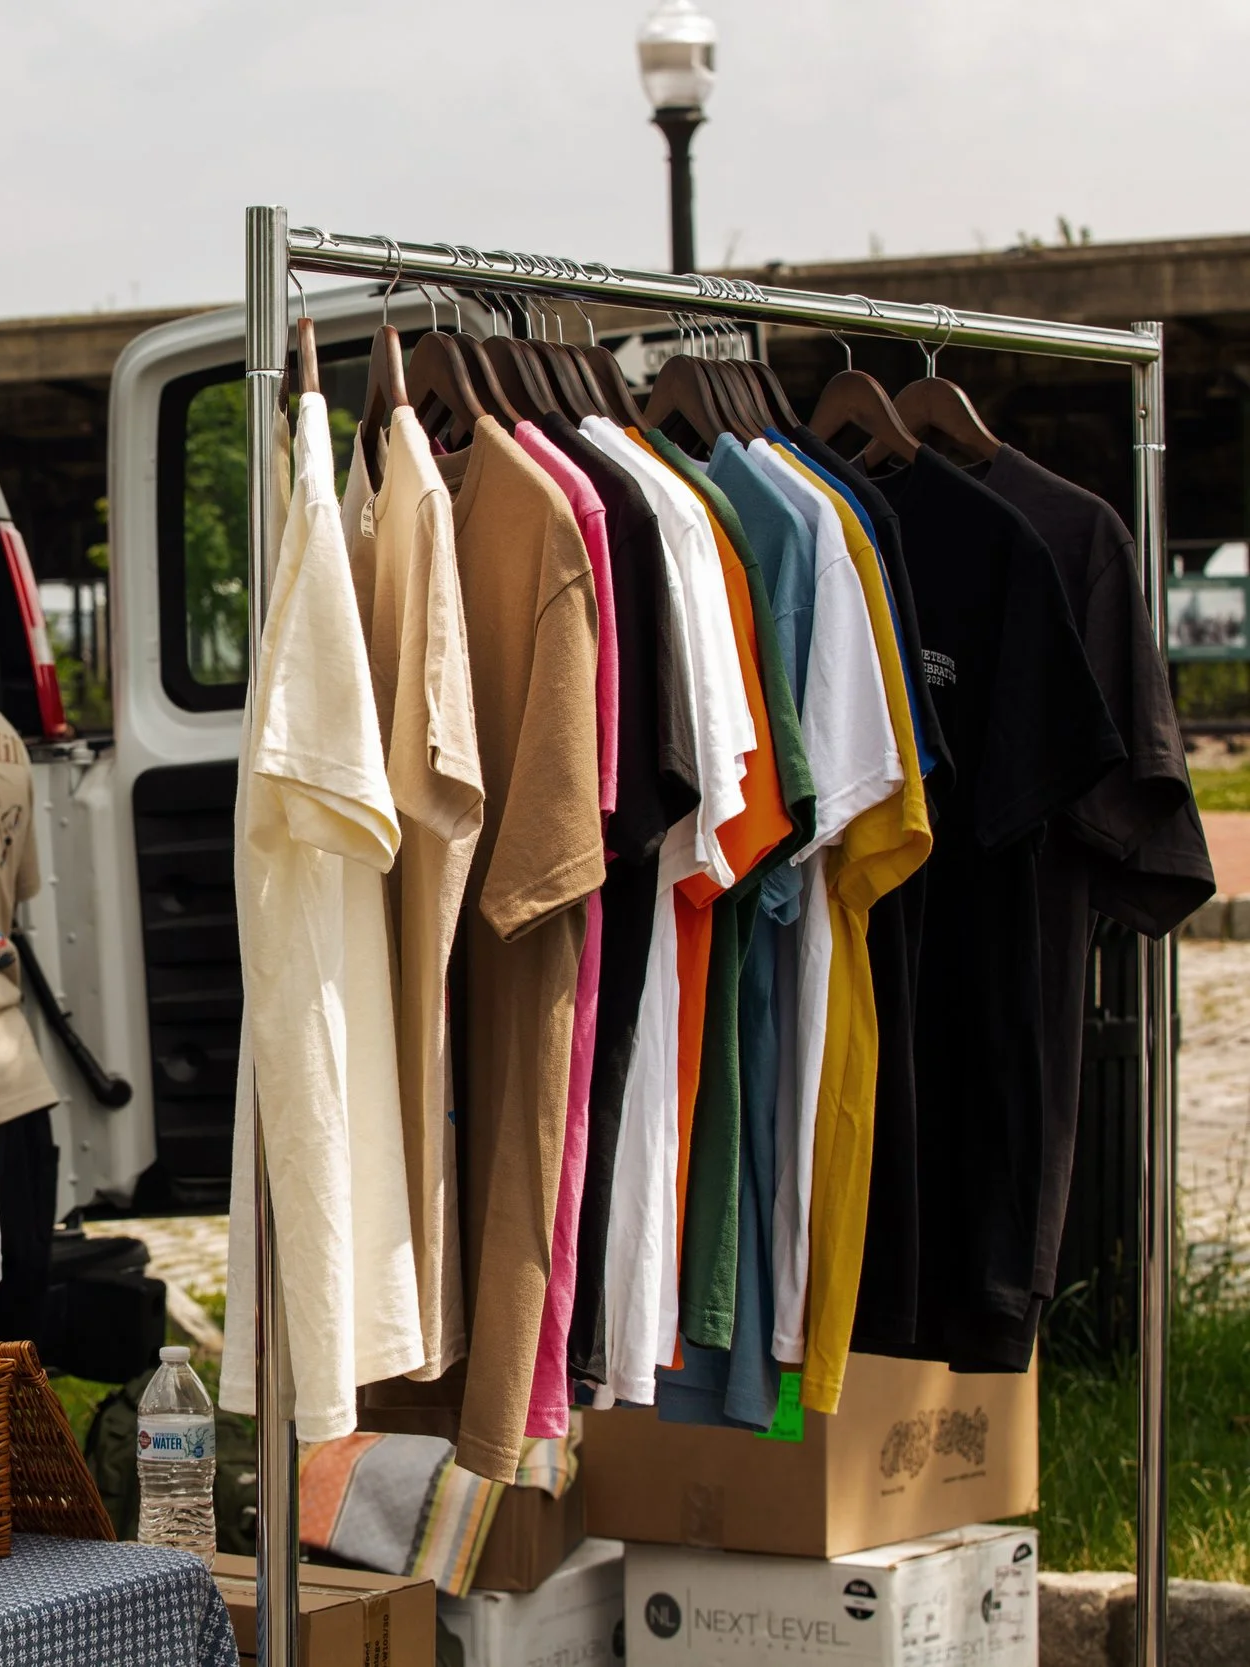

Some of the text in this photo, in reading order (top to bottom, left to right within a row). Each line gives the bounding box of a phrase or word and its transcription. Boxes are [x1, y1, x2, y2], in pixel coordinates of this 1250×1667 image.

[926, 674, 945, 687] 2021
[152, 1436, 183, 1450] WATER
[650, 1605, 676, 1629] NL
[694, 1607, 759, 1636] NEXT
[767, 1607, 851, 1647] LEVEL
